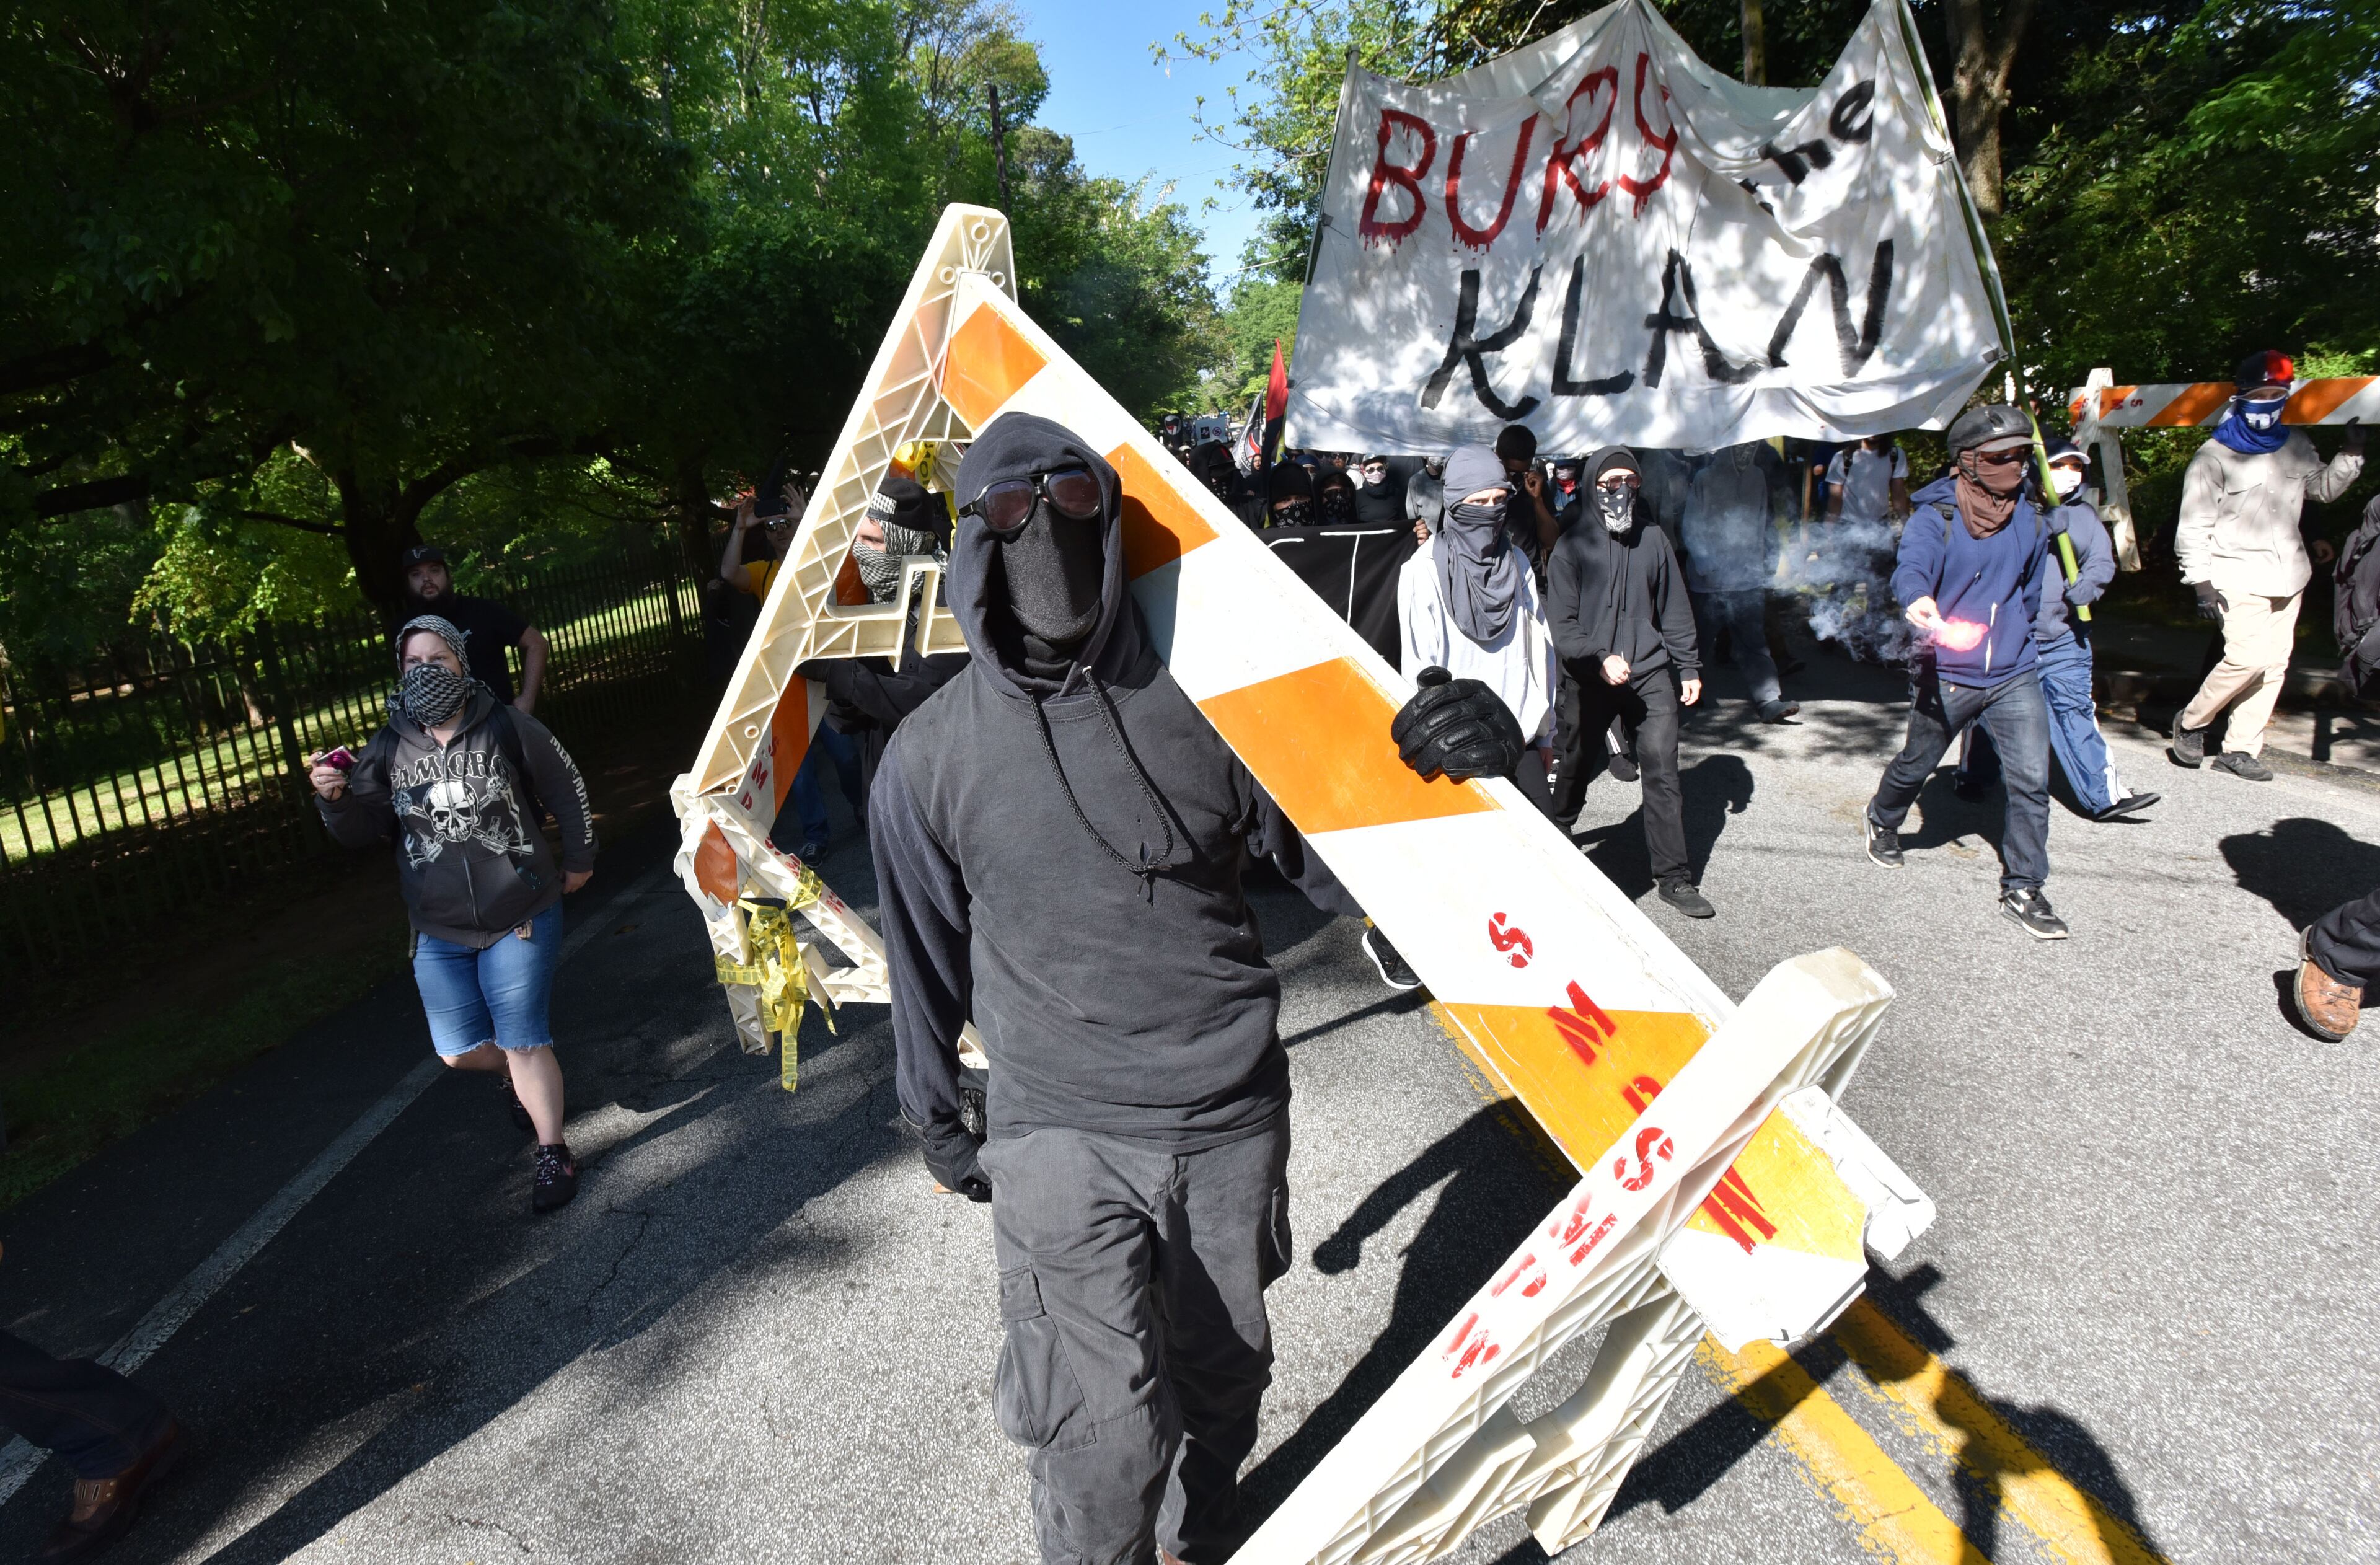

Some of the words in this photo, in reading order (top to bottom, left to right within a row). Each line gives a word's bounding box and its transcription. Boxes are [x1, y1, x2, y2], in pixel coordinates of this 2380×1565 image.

[1738, 79, 1875, 218] he
[1420, 239, 1894, 421] KLAN
[549, 735, 573, 769] MEN
